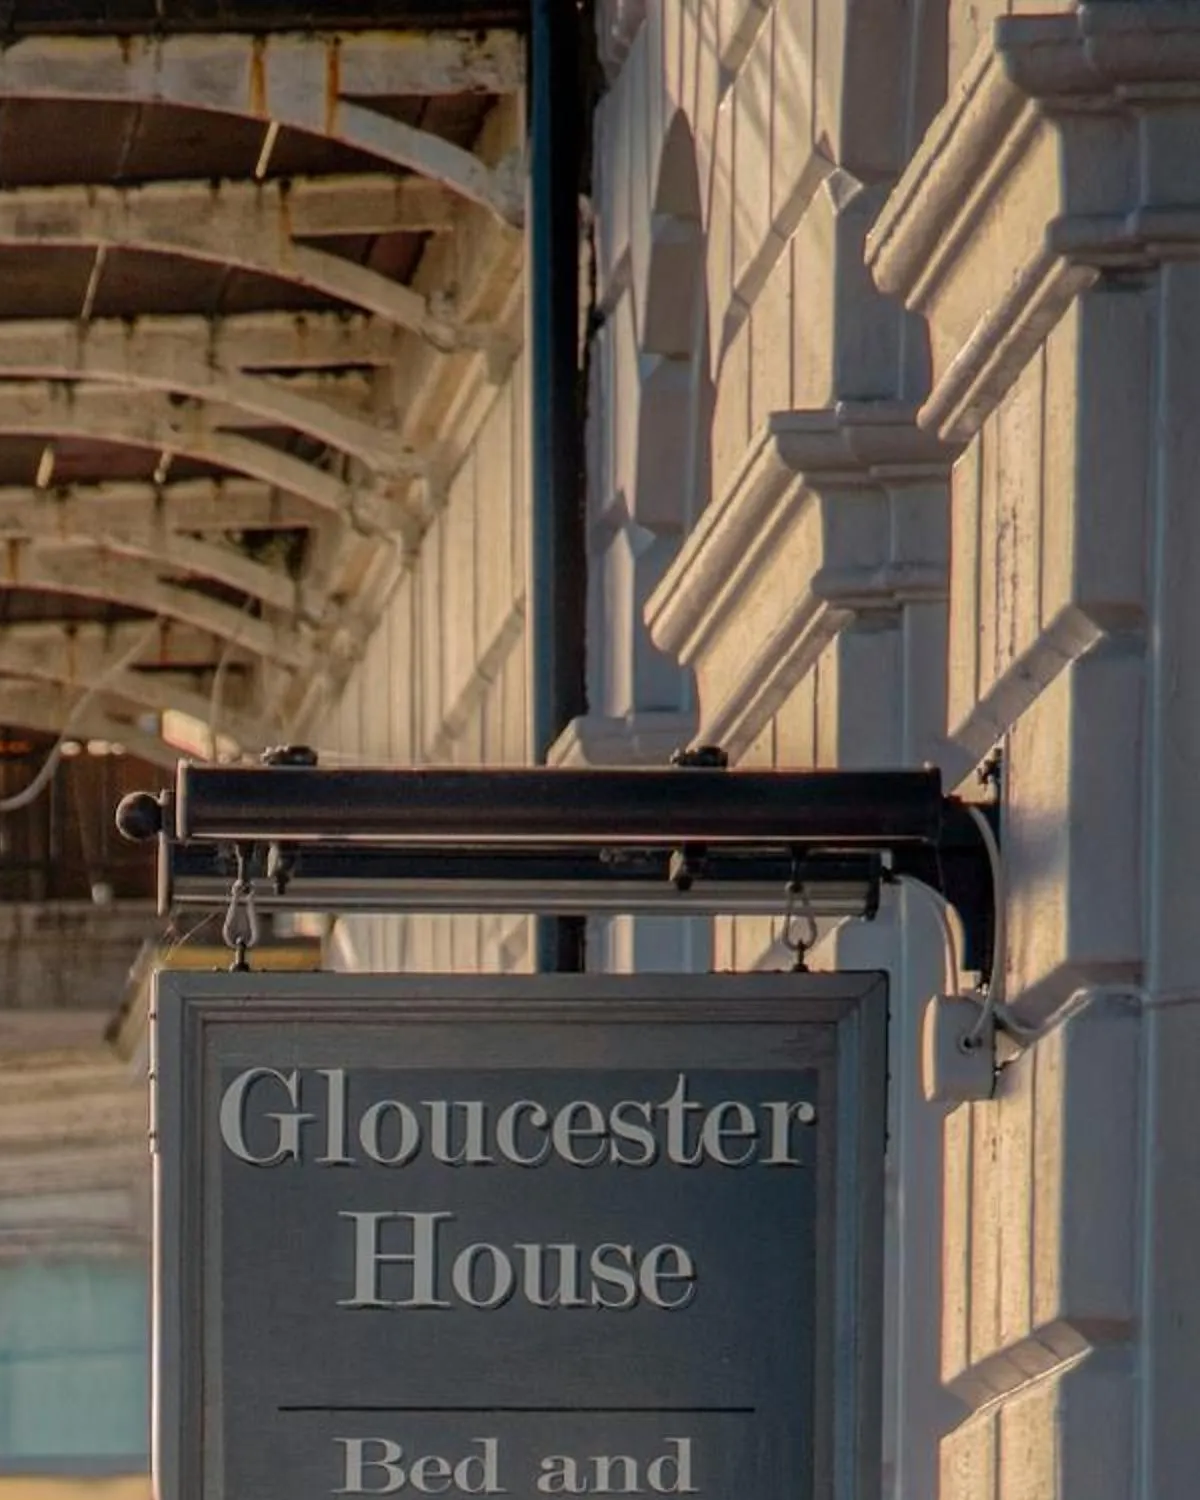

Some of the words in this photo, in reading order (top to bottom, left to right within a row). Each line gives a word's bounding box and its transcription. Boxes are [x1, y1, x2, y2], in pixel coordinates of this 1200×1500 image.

[219, 1066, 816, 1167] Gloucester
[337, 1210, 696, 1309] House
[332, 1437, 506, 1494] Bed
[536, 1437, 700, 1494] and
